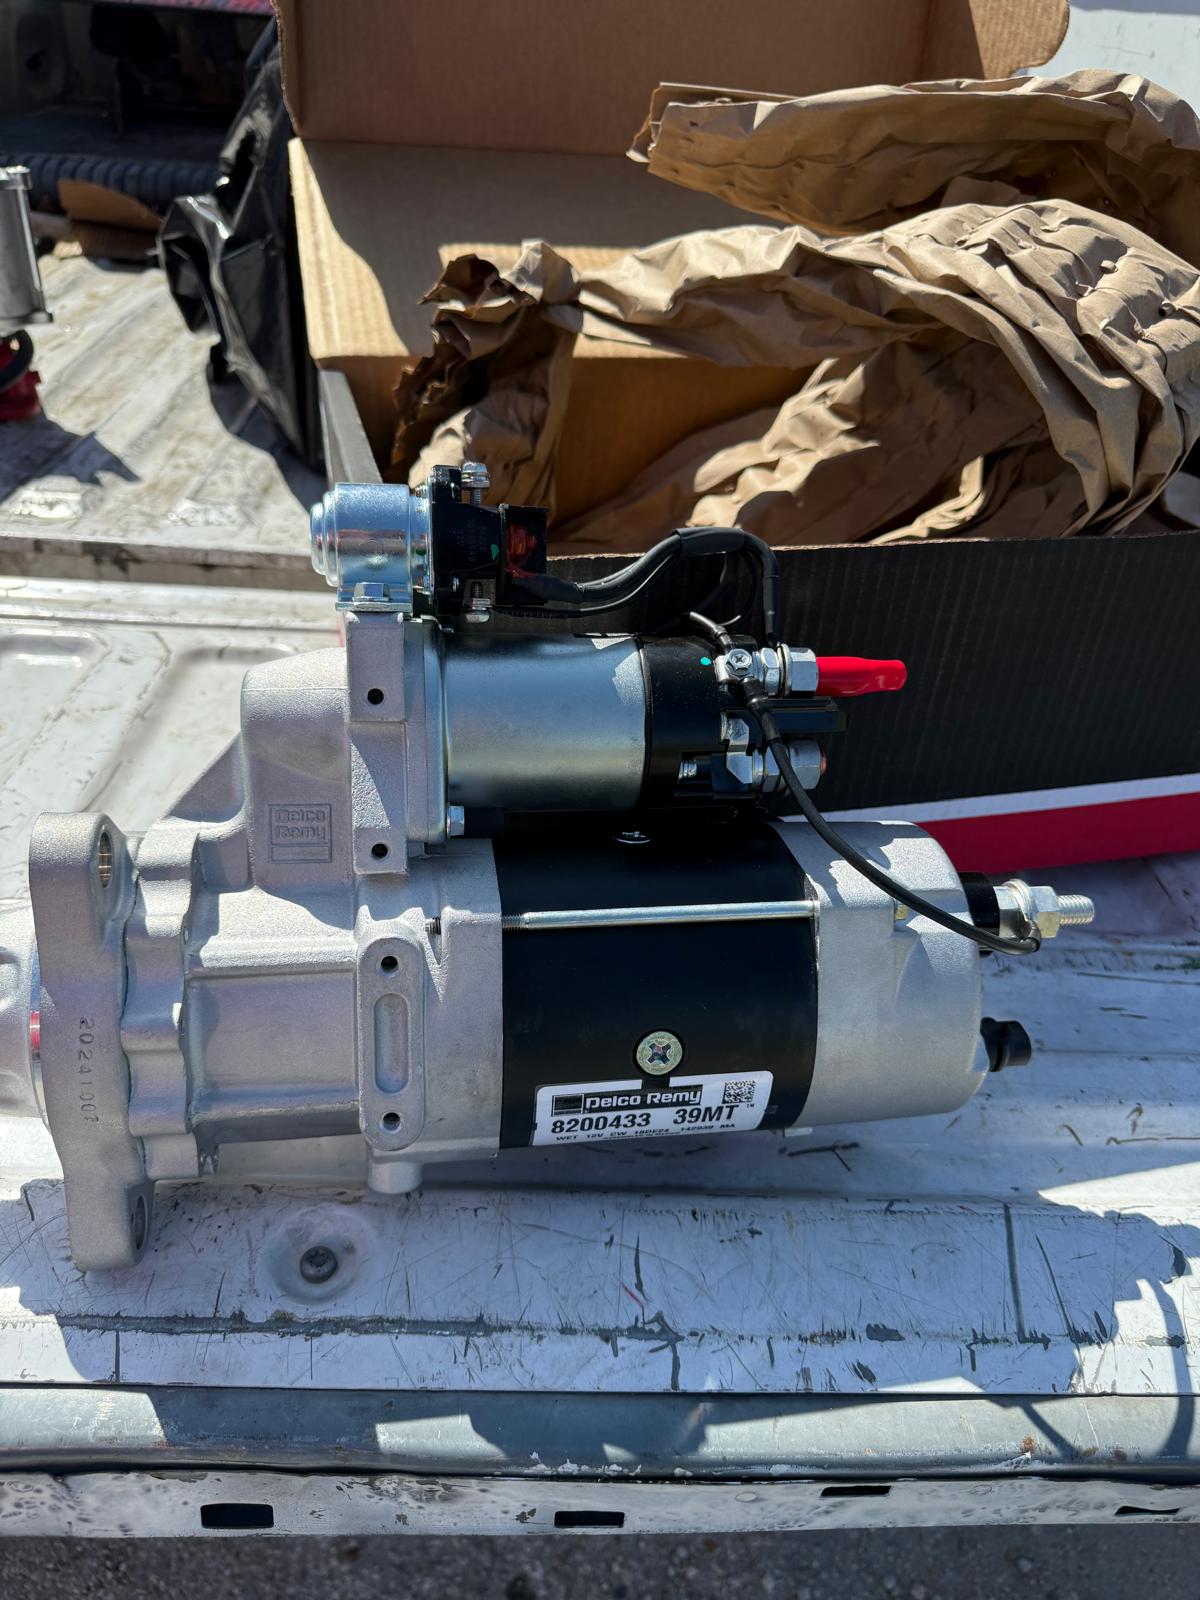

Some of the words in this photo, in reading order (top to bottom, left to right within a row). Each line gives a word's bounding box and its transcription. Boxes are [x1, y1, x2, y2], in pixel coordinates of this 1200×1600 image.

[585, 1095, 641, 1109] Delco
[646, 1091, 701, 1105] Remy
[551, 1112, 652, 1134] 8200433
[673, 1104, 740, 1125] 39MT
